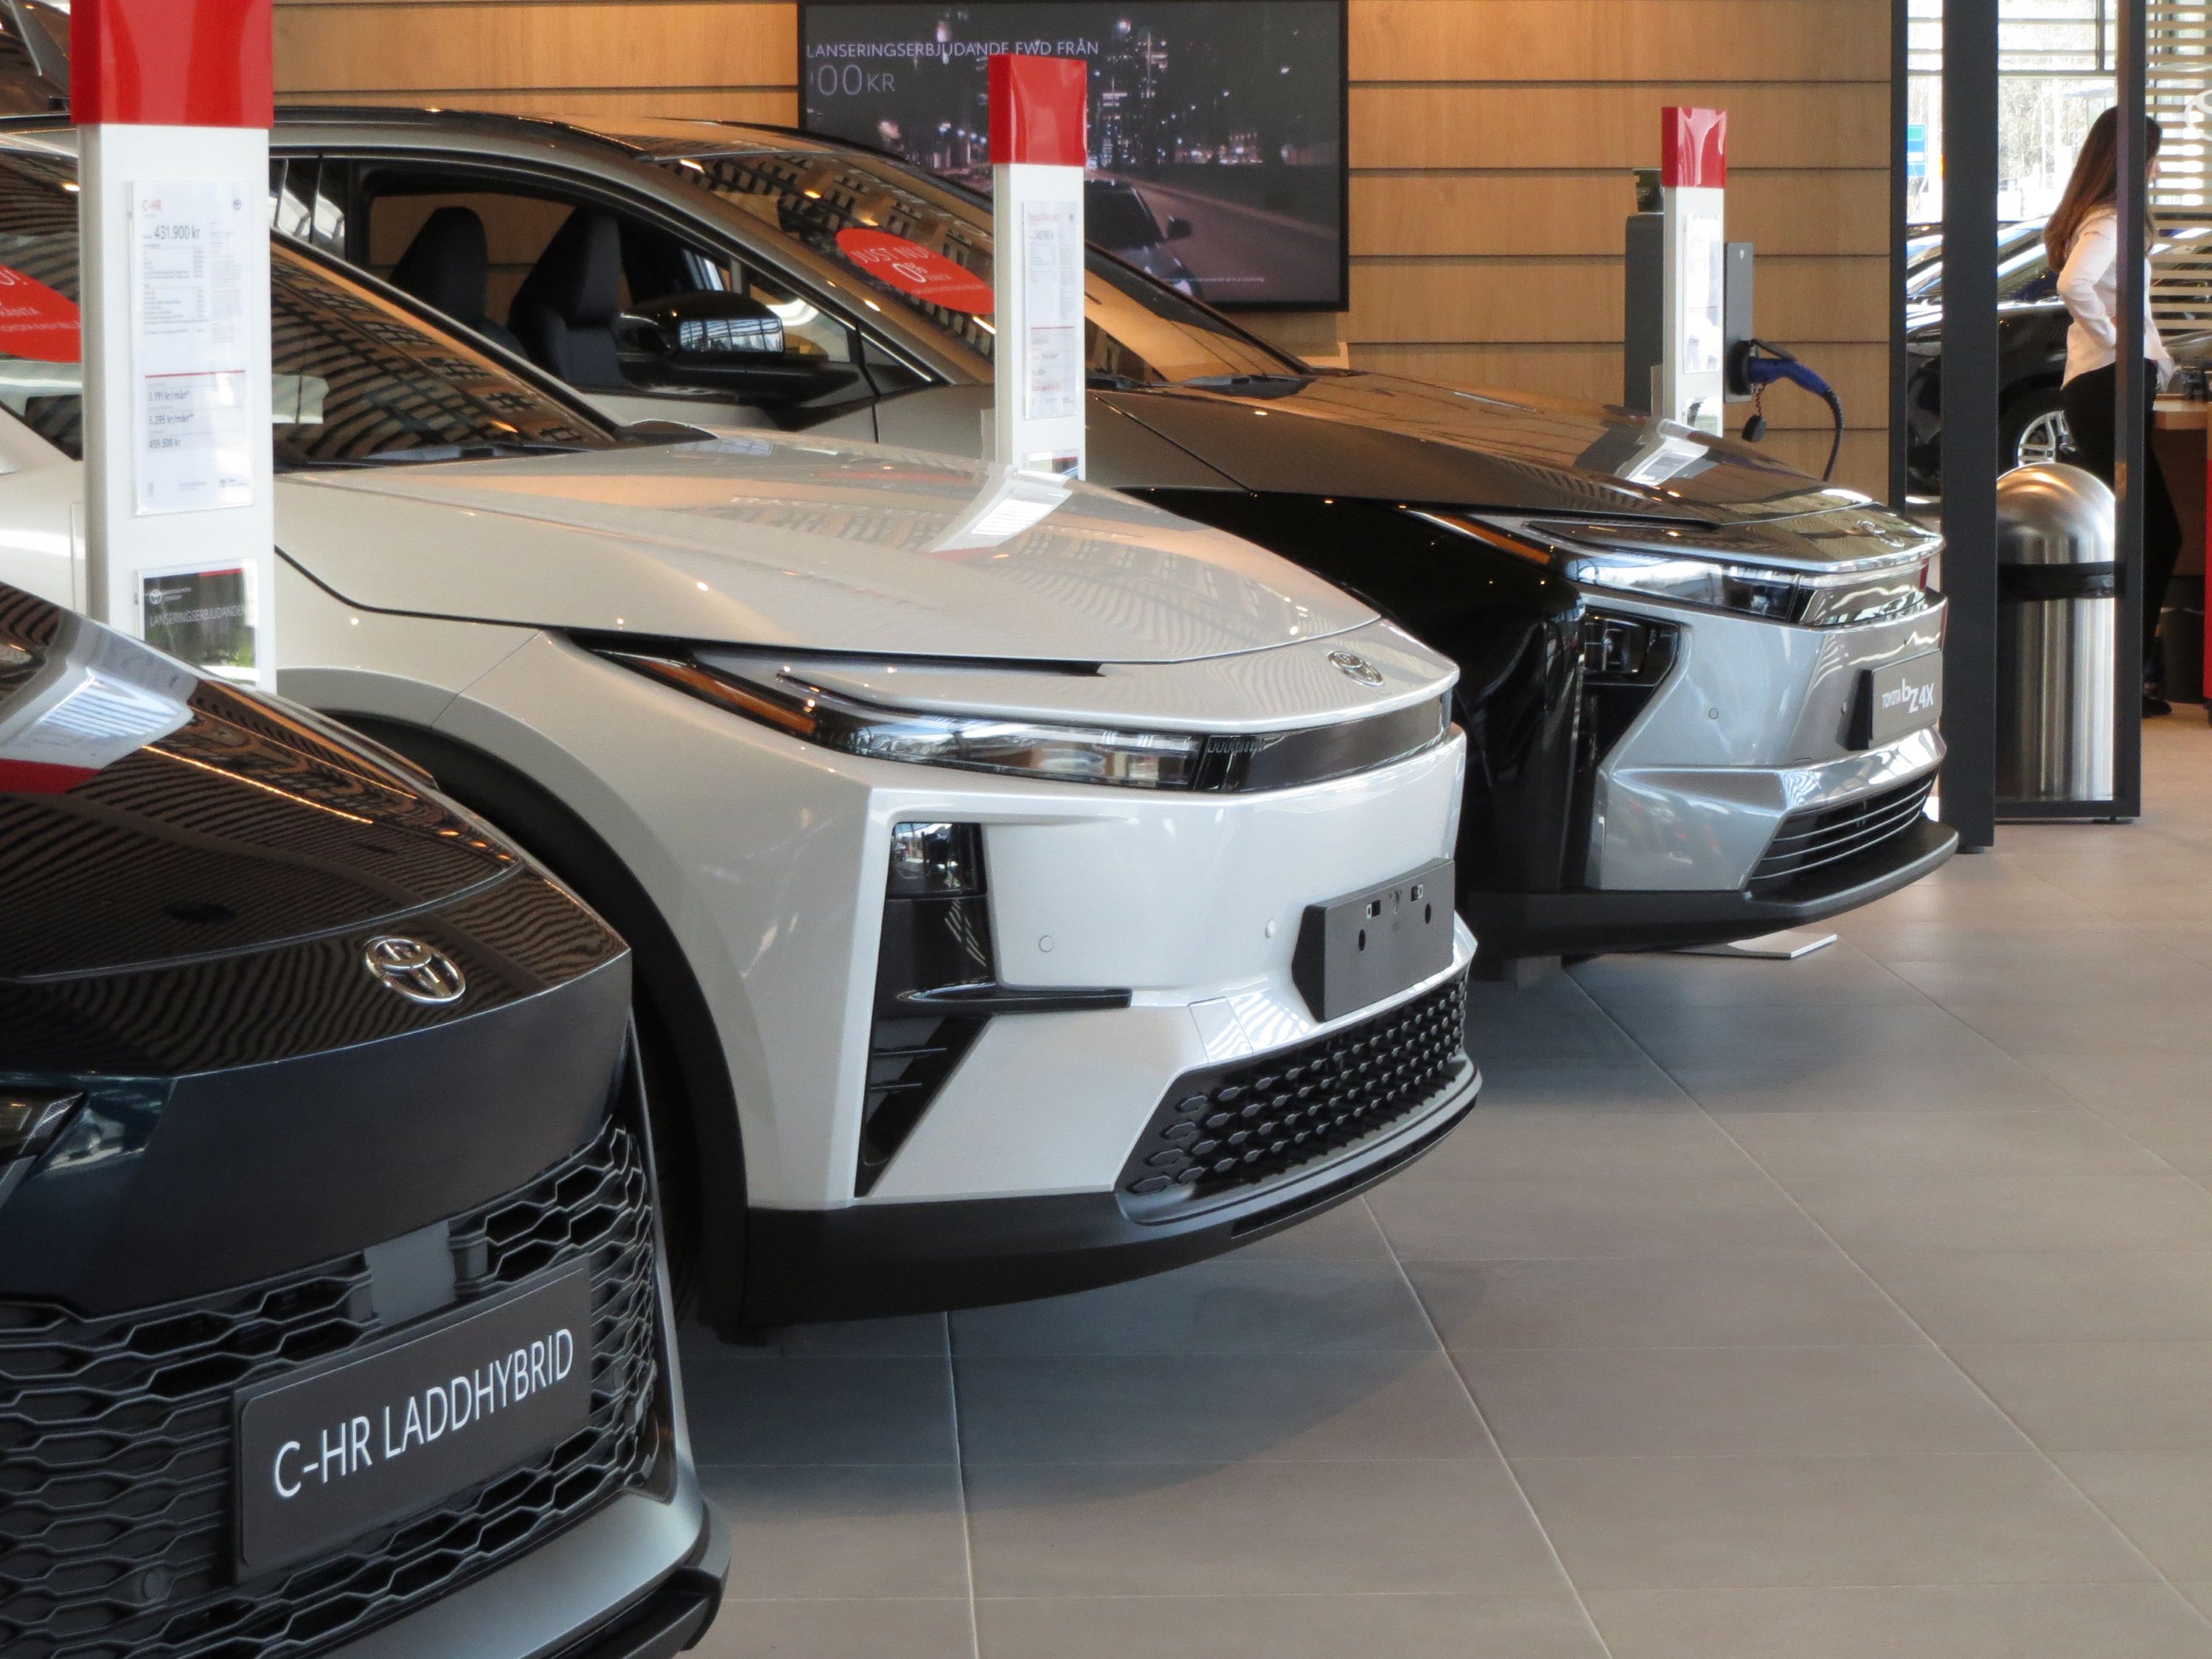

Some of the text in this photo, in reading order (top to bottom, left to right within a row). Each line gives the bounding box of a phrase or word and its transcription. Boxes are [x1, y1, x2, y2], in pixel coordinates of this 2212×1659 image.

[807, 38, 1099, 58] LANSERINGSERBJUDANDE FWD FRÅN
[810, 63, 895, 96] 00 KR
[154, 224, 201, 240] 431.900 kr
[274, 1328, 574, 1498] C-HR LADDHYBRID
